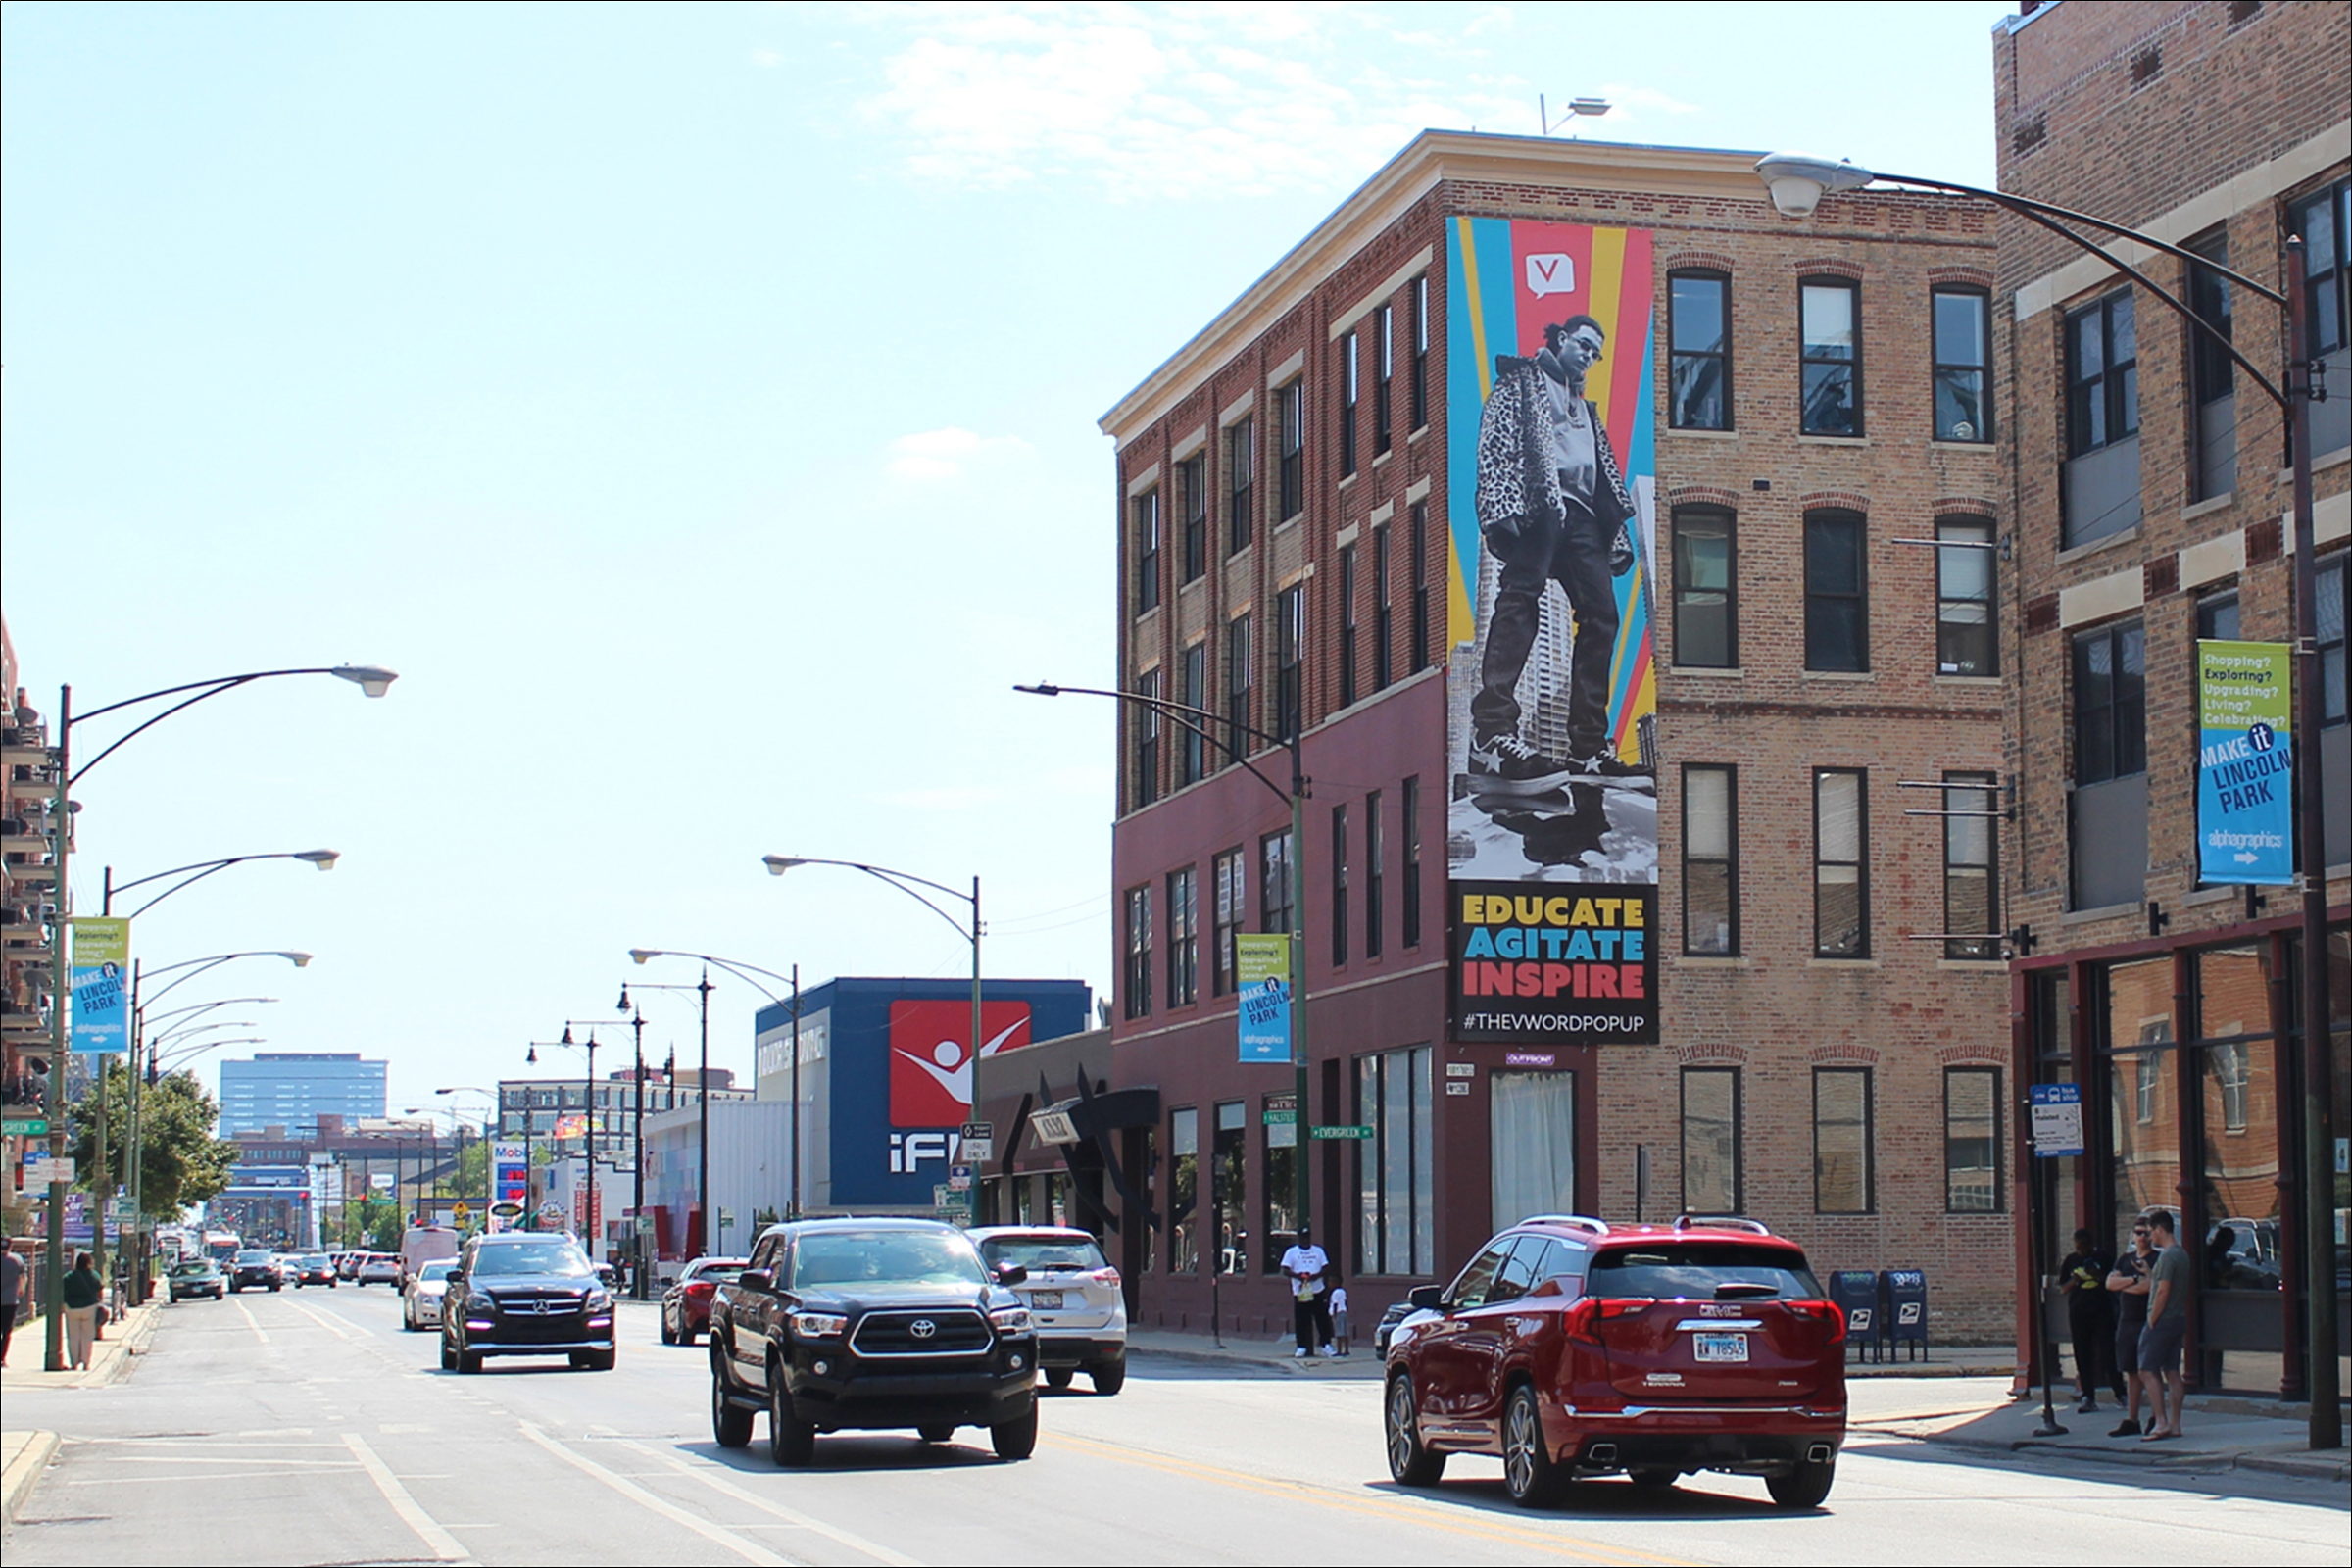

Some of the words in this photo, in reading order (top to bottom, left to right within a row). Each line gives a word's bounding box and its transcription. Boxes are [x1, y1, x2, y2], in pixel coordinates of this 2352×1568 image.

[1535, 259, 1559, 283] V
[2204, 654, 2271, 667] Shopping?
[2204, 668, 2272, 683] Exploring?
[2204, 684, 2278, 699] Upgrading?
[2204, 699, 2251, 711] Living?
[2204, 713, 2286, 729] Celebrating?
[2201, 736, 2251, 768] MAKE
[2252, 726, 2272, 752] it
[2212, 748, 2292, 790] LINCOLN
[2219, 780, 2274, 814] PARK
[2208, 829, 2283, 849] alphagraphics
[1462, 894, 1645, 927] EDUCATE
[1463, 927, 1645, 961] AGITATE
[73, 969, 103, 989] MAKE
[1462, 961, 1645, 999] INSPIRE
[1239, 984, 1266, 1003] MAKE
[1245, 990, 1291, 1013] LINCOLN
[83, 995, 118, 1014] PARK
[1250, 1007, 1280, 1026] PARK
[1463, 1013, 1645, 1032] #THEVWORDPOPUP
[1319, 1127, 1360, 1137] EVERGREEN
[1699, 1304, 1742, 1317] GMC
